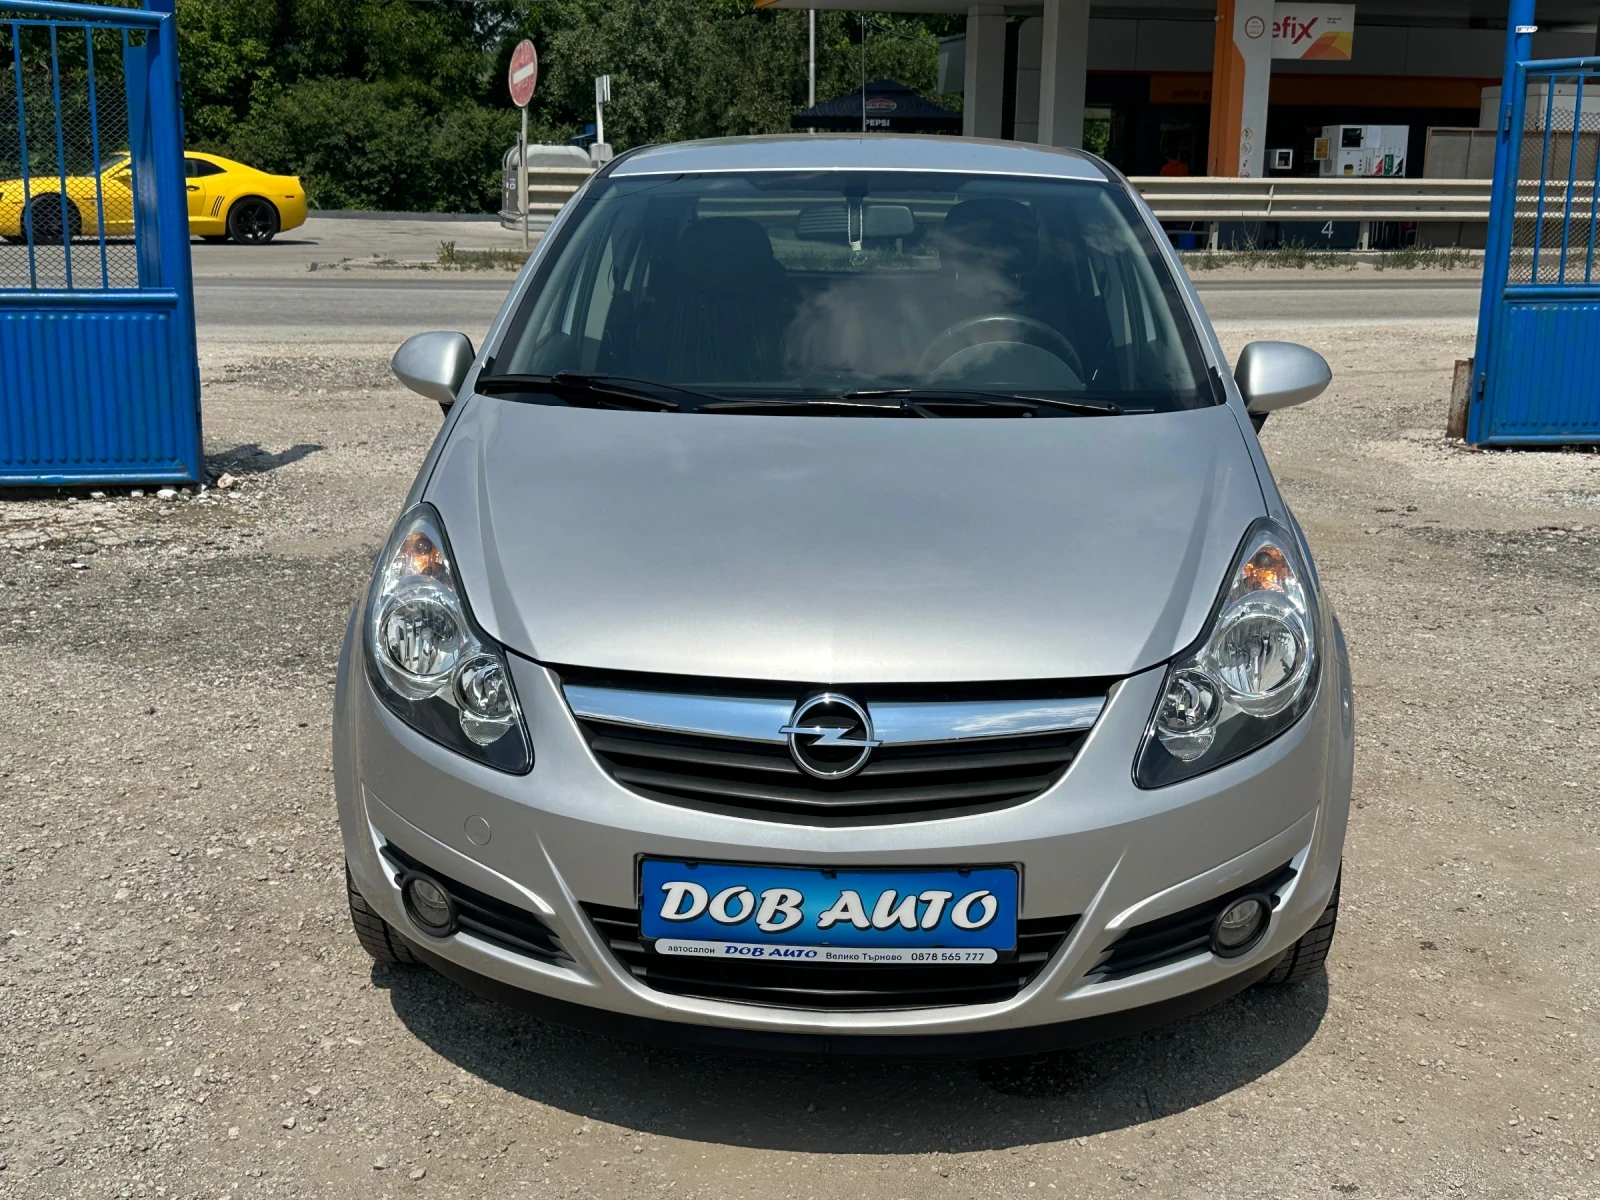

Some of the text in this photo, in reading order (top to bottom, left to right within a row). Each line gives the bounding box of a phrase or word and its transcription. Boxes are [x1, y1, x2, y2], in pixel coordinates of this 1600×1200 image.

[1321, 220, 1334, 239] 4
[660, 881, 998, 933] DOB AUTO
[667, 945, 985, 963] автосалон DOB AUTO Велико Търново 0878 565 777
